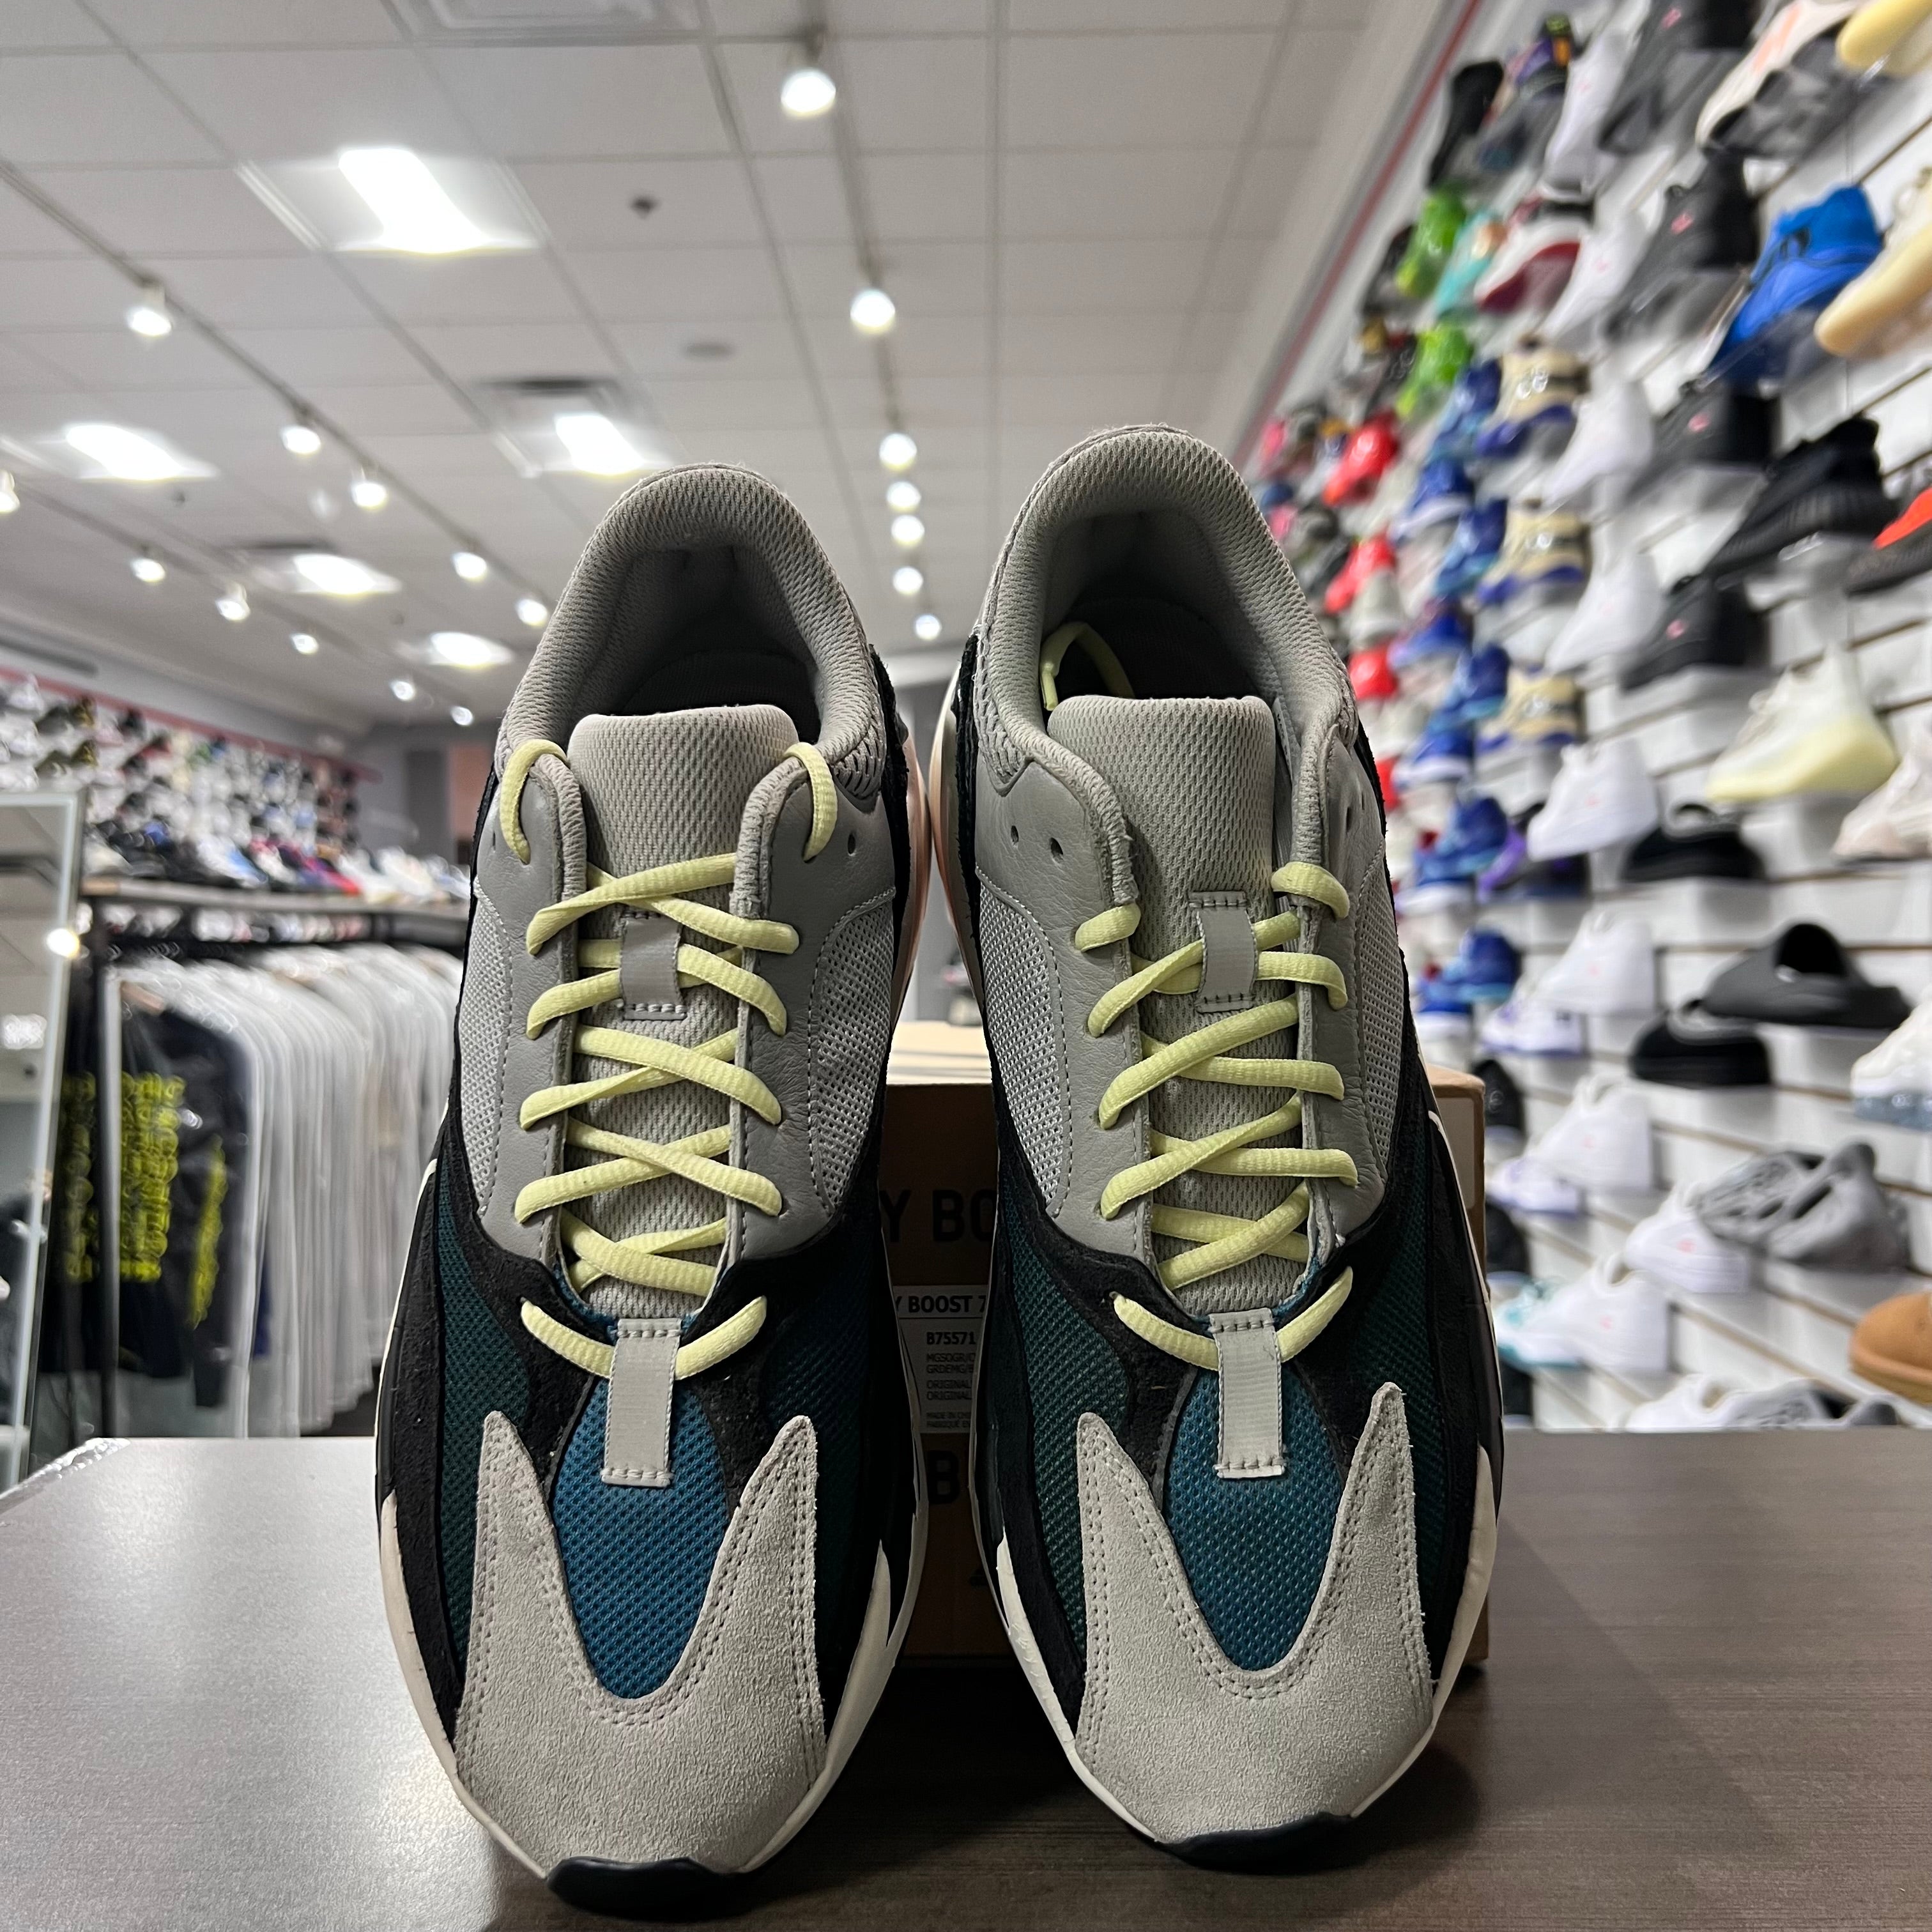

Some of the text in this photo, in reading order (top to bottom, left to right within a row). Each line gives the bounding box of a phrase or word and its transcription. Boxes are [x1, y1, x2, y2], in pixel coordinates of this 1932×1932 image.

[908, 1296, 972, 1313] BOOST
[926, 1331, 976, 1345] B75571
[926, 1379, 972, 1389] ORIGINAL
